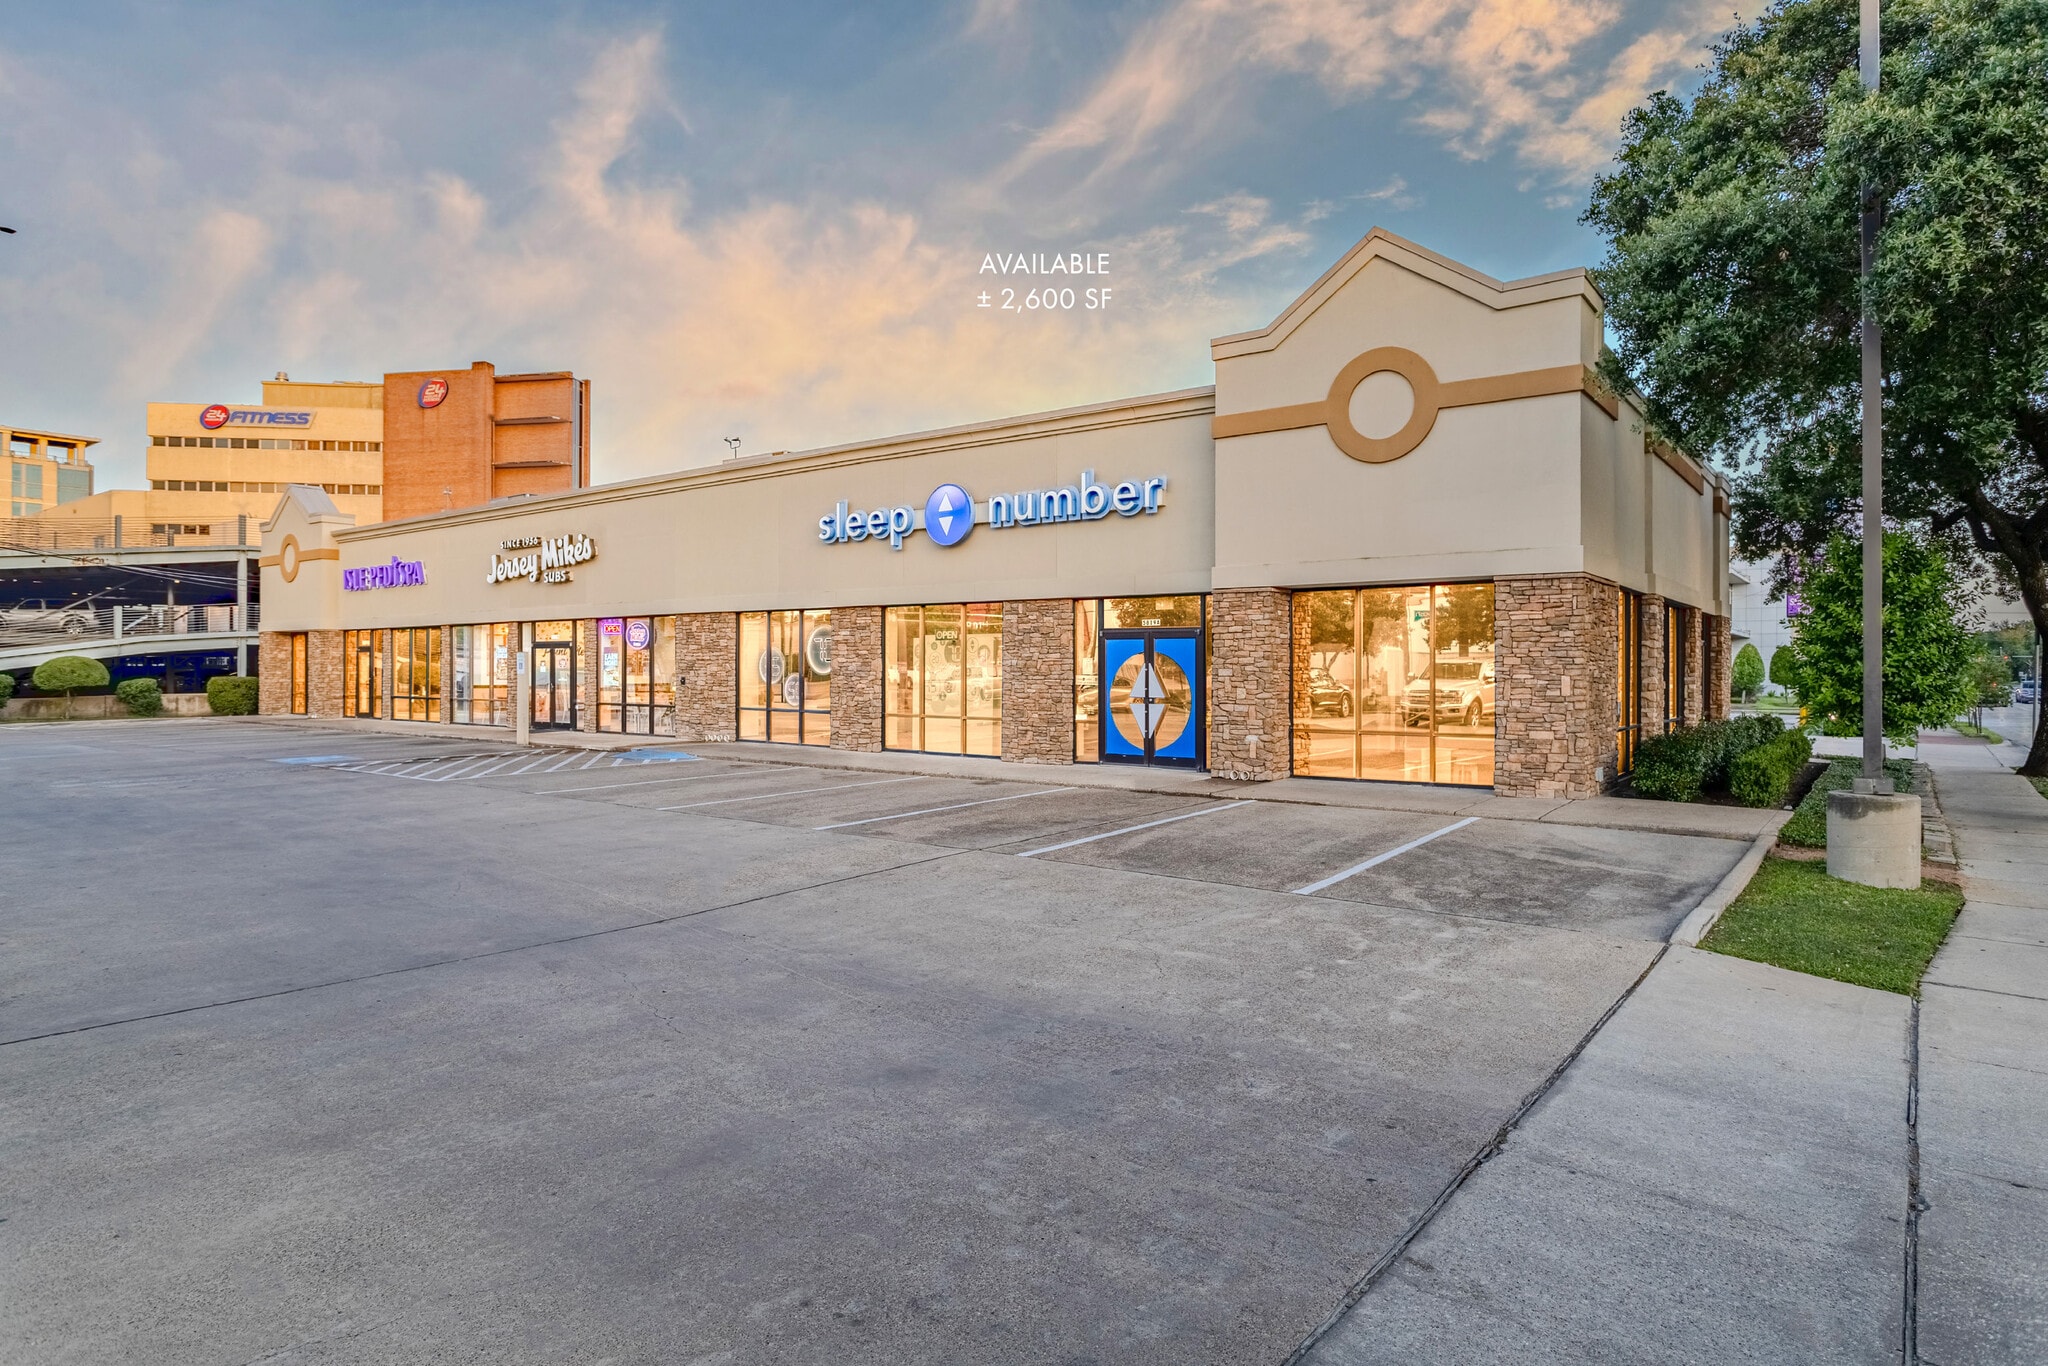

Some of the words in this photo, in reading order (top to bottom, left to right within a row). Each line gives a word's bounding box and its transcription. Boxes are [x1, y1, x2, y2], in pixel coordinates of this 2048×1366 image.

[426, 384, 445, 397] 24
[206, 409, 227, 421] 24
[229, 411, 312, 425] FITNESS
[818, 500, 914, 550] sleep
[988, 470, 1166, 528] number
[500, 539, 521, 550] SINCE
[522, 536, 541, 548] 1956
[486, 554, 541, 584] Jersey
[541, 533, 595, 571] Mike's
[543, 570, 570, 583] SUBS
[605, 625, 621, 633] OPEN
[936, 629, 958, 641] OPEN
